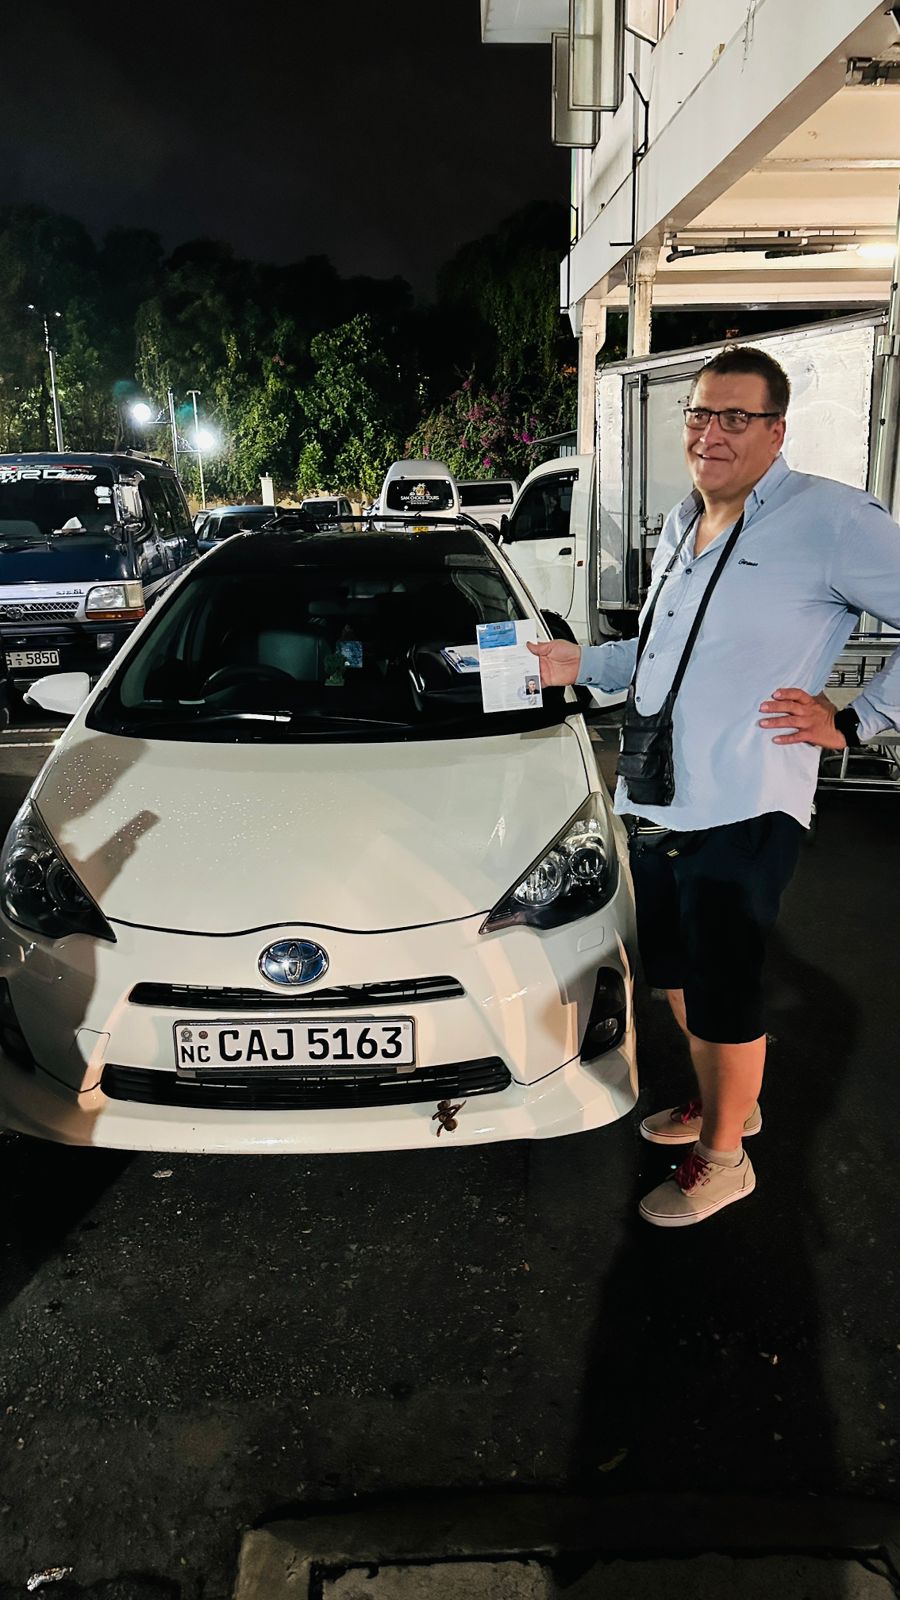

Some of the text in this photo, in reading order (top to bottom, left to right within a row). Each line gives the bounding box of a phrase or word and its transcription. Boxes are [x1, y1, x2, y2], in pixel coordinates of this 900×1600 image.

[26, 652, 58, 665] 5850
[180, 1026, 403, 1063] NC CAJ 5163
